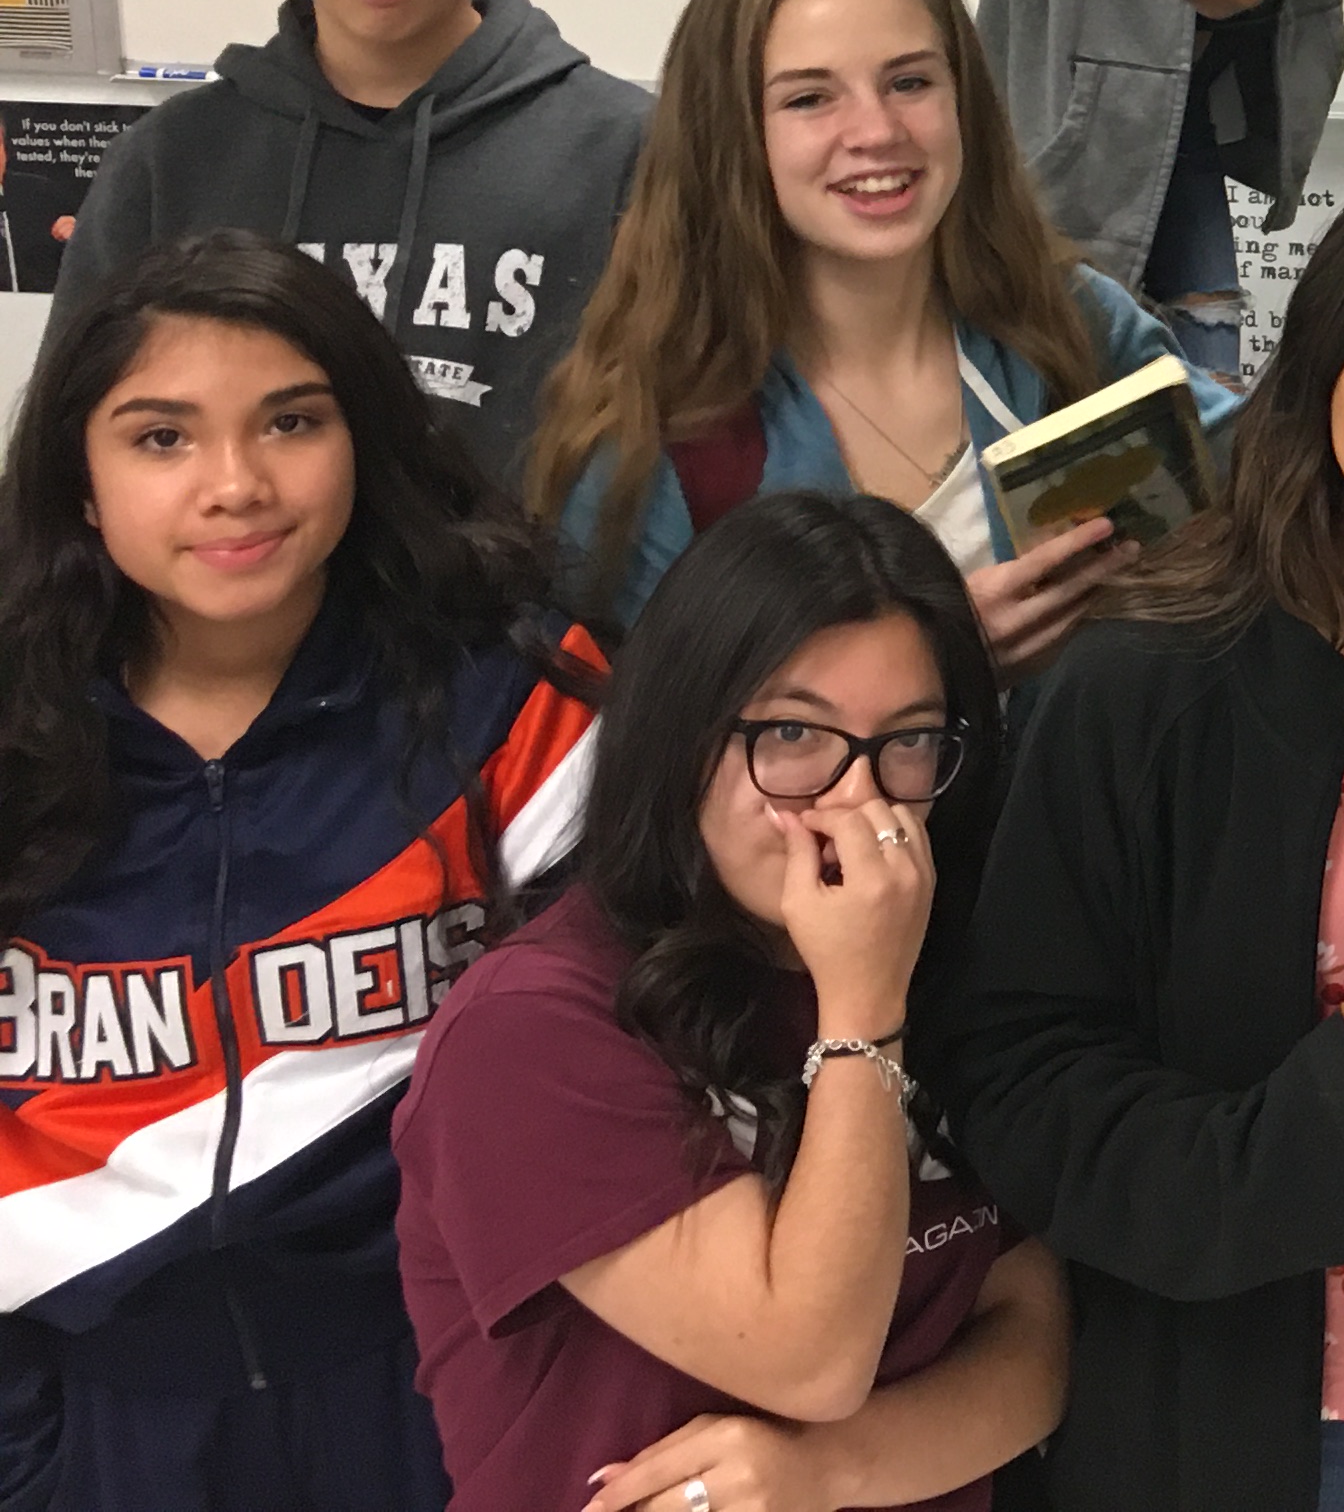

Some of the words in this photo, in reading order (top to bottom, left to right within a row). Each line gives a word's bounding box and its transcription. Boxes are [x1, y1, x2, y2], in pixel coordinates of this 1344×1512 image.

[22, 117, 31, 130] If
[34, 121, 57, 134] you
[59, 118, 90, 132] don't
[94, 121, 120, 133] stick
[11, 134, 50, 147] values
[53, 134, 86, 148] when
[16, 149, 57, 164] tested,
[1227, 185, 1239, 204] I
[1301, 189, 1335, 207] ot
[295, 243, 546, 338] XAS
[416, 359, 464, 381] TATE
